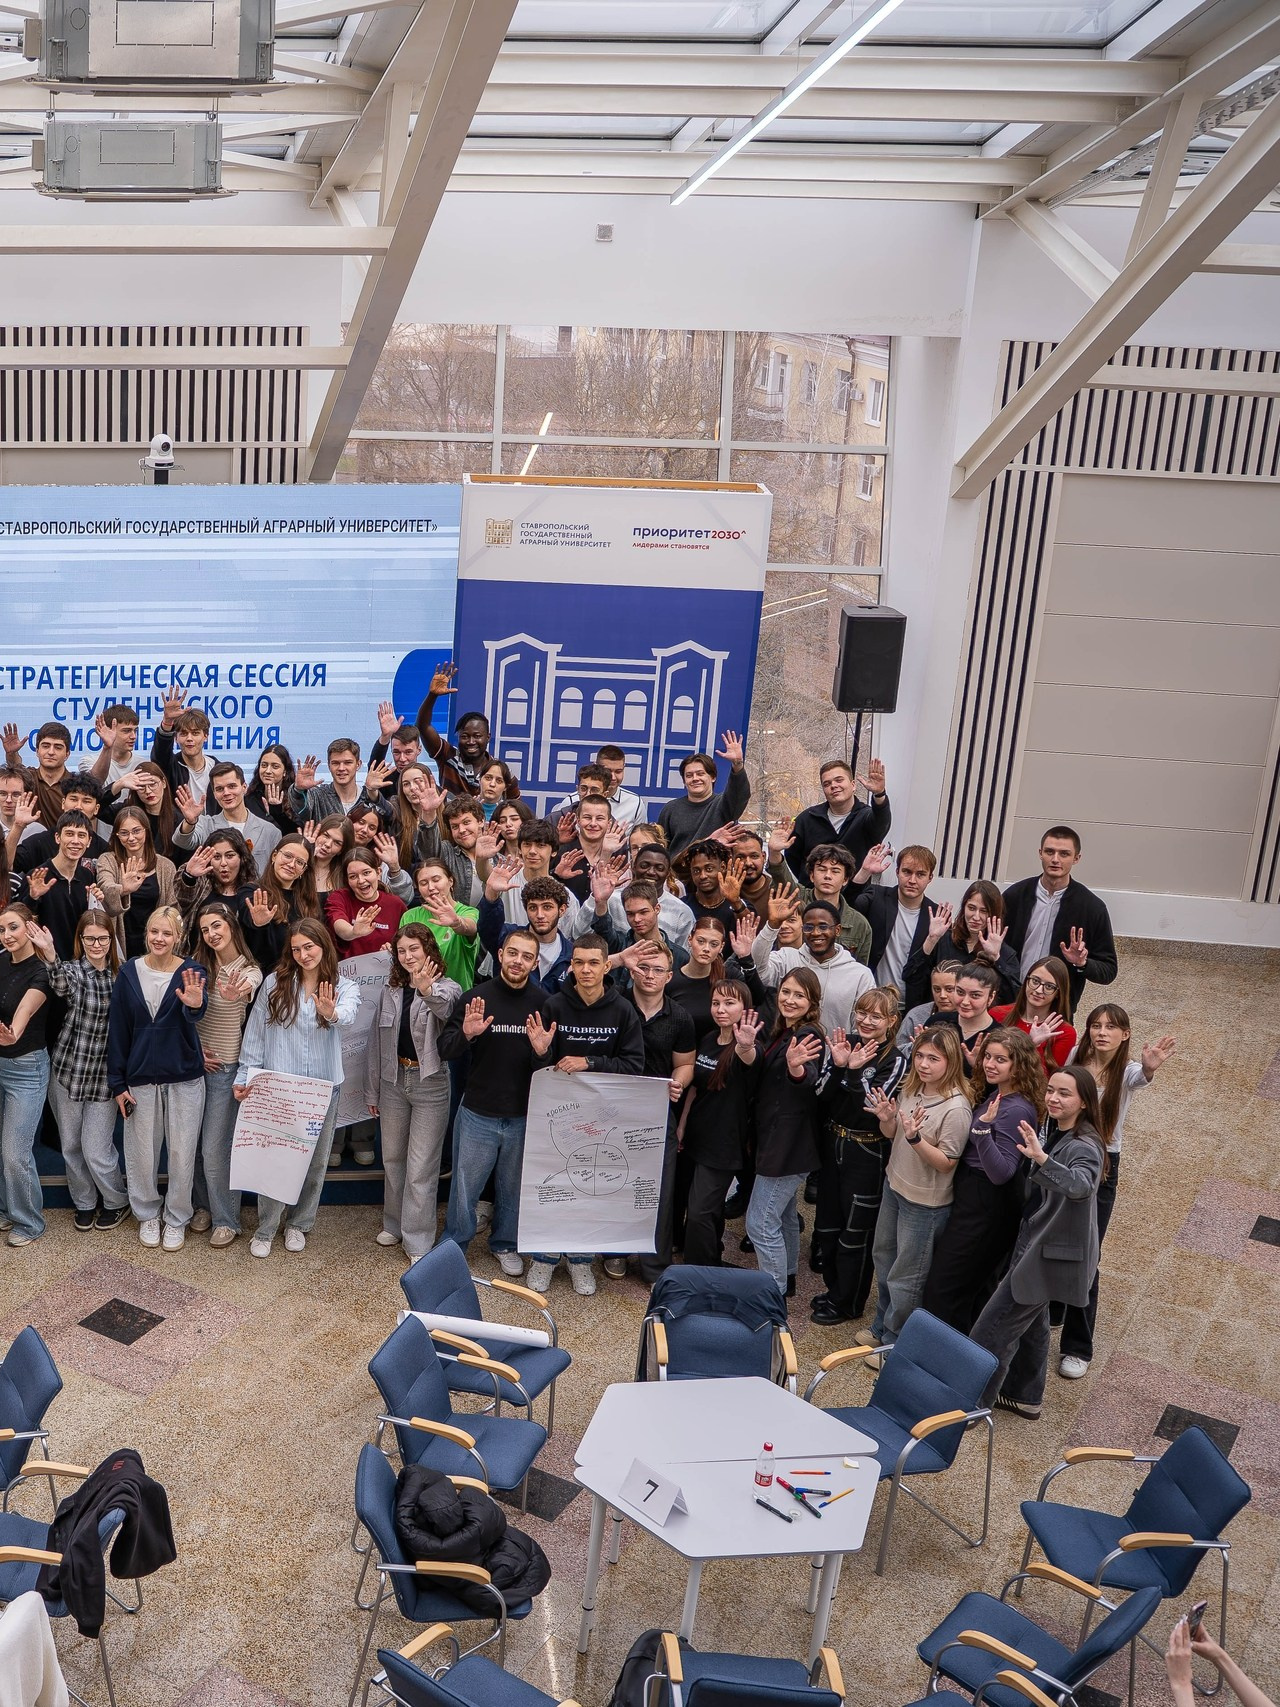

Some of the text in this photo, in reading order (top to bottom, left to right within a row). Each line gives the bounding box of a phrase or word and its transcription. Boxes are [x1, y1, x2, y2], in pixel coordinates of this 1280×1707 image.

[125, 516, 259, 536] ГОСУДАРСТВЕННЫЙ
[262, 516, 335, 534] АГРАРНЫЙ
[339, 518, 438, 533] УНИВЕРСИТЕТ»
[520, 522, 590, 531] СТАВРОПОЛЬСКИЙ
[520, 530, 593, 539] ГОСУДАРСТВЕННЫЙ
[519, 538, 612, 548] АГРАРНЫЙ УНИВЕРСИТЕТ
[228, 663, 326, 688] СЕССИЯ
[558, 1025, 619, 1034] BURBERRY
[642, 1478, 660, 1503] 7
